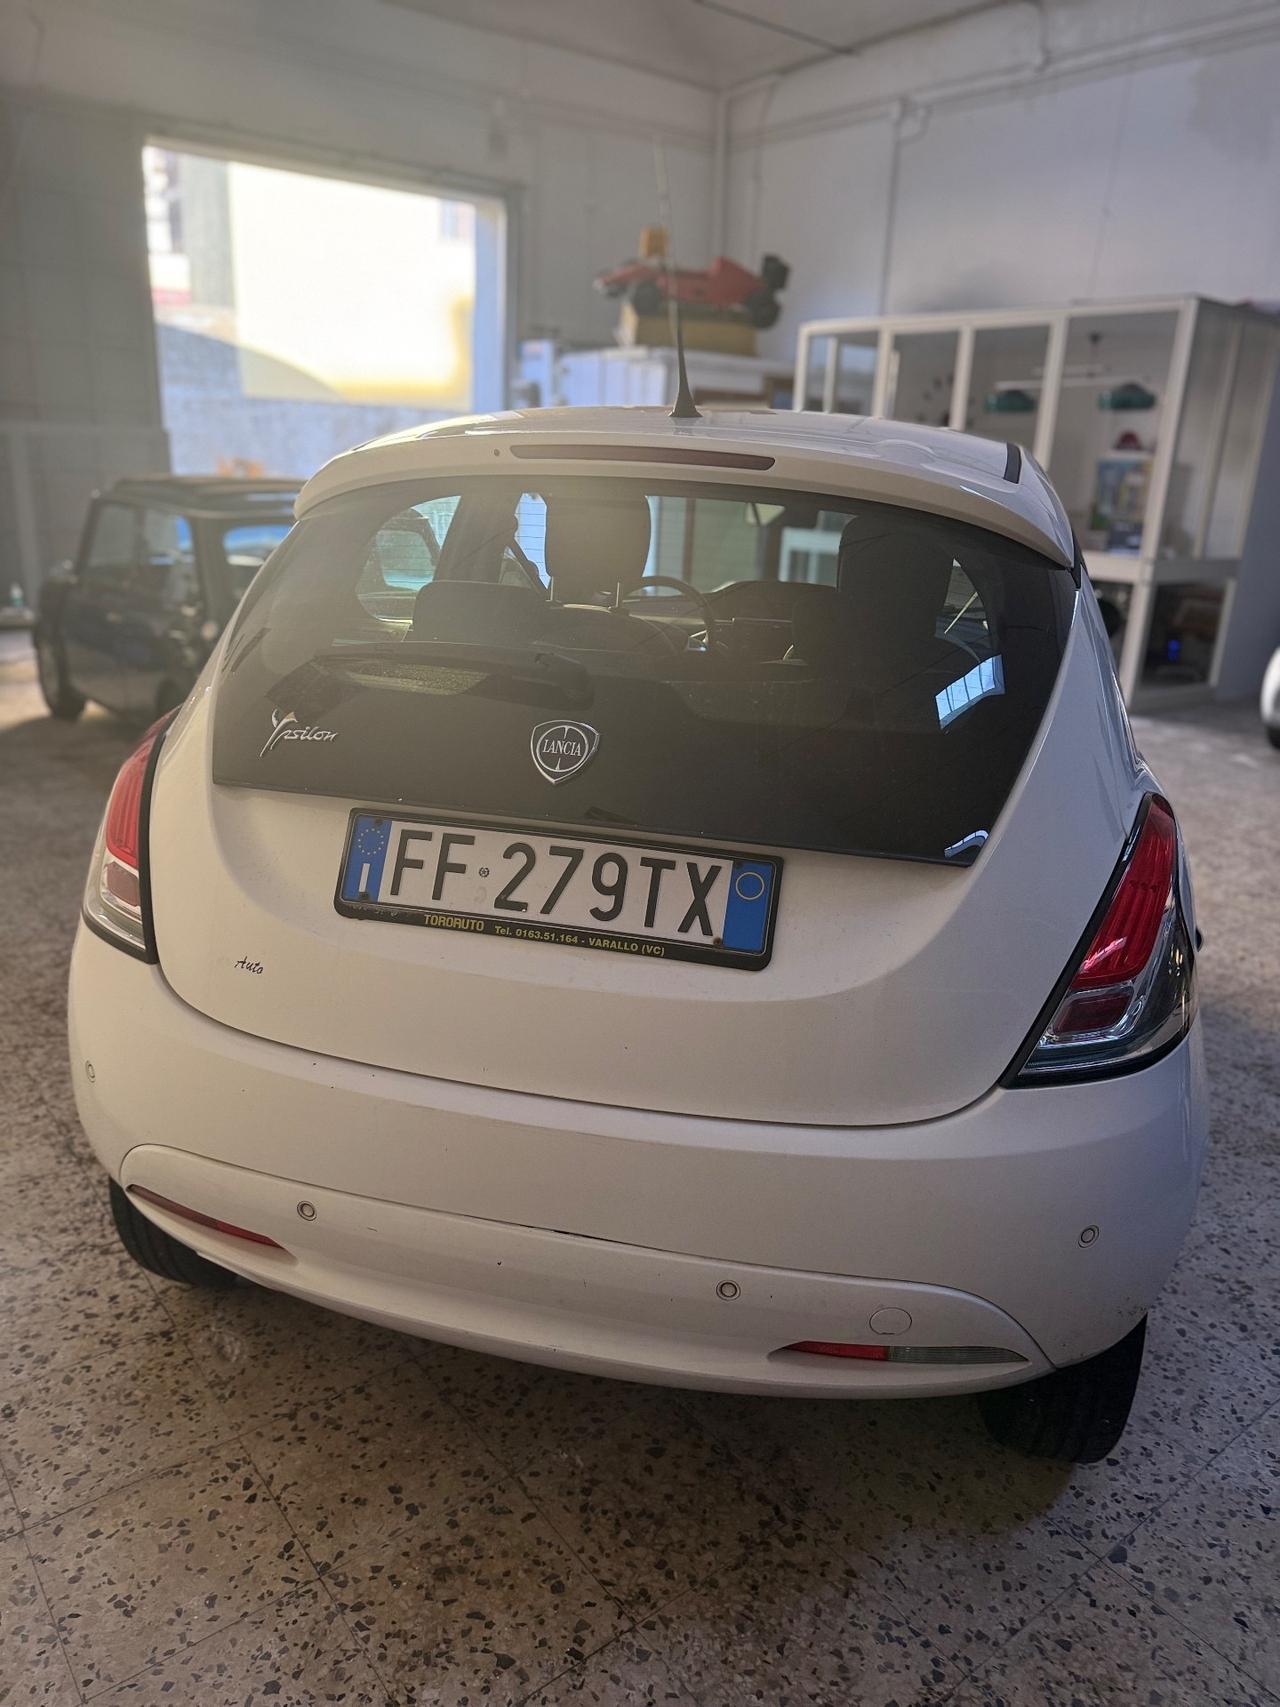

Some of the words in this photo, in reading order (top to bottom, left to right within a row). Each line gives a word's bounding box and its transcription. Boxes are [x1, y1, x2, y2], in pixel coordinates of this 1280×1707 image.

[260, 708, 338, 757] Ypsilon
[542, 739, 582, 757] LANCIA
[390, 829, 476, 901] FF
[493, 841, 722, 937] 279TX
[494, 925, 512, 936] Tel.
[515, 928, 579, 944] 0163.51.164
[588, 937, 639, 952] VARALLO
[641, 944, 665, 957] (VC)
[234, 955, 264, 975] Auto
